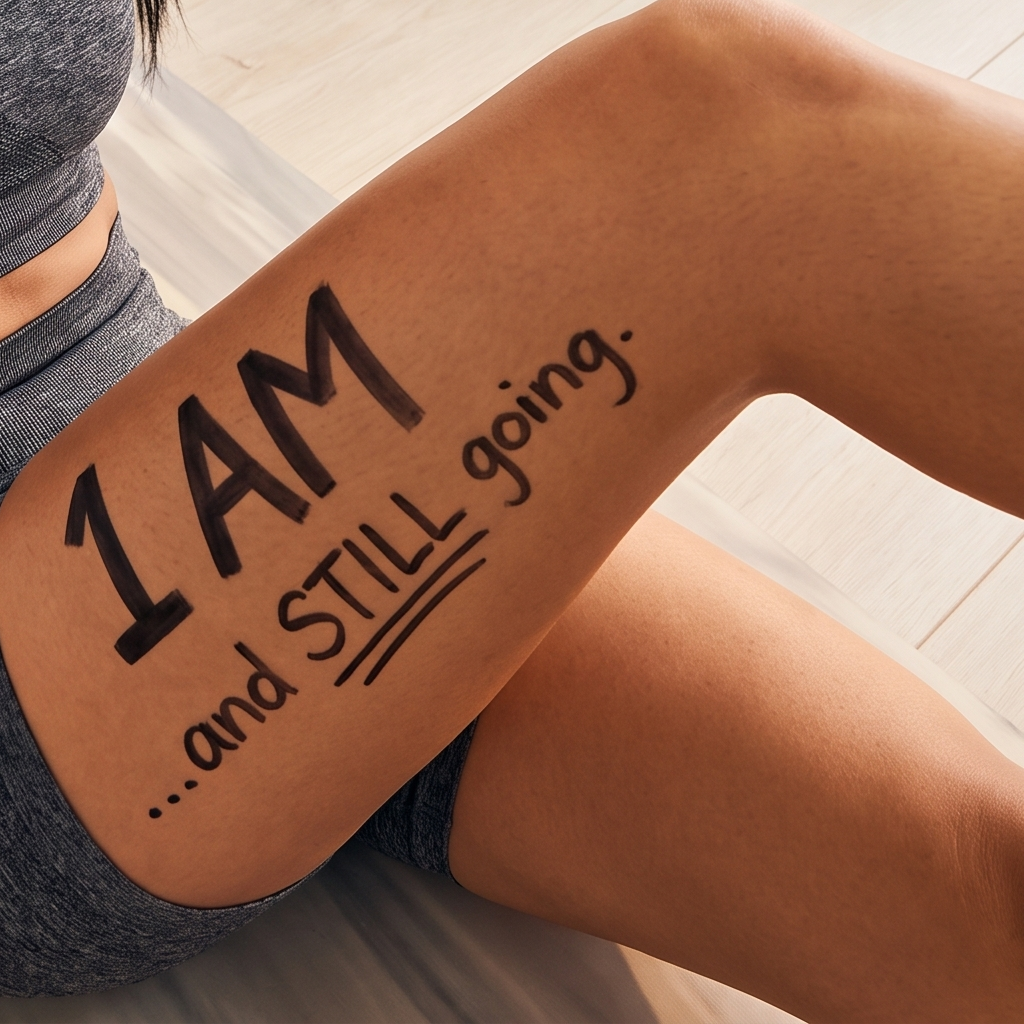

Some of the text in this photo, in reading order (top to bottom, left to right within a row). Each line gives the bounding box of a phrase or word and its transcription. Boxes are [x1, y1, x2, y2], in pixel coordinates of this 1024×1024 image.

[177, 281, 426, 579] AM
[277, 492, 467, 662] STILL
[462, 329, 637, 508] going.
